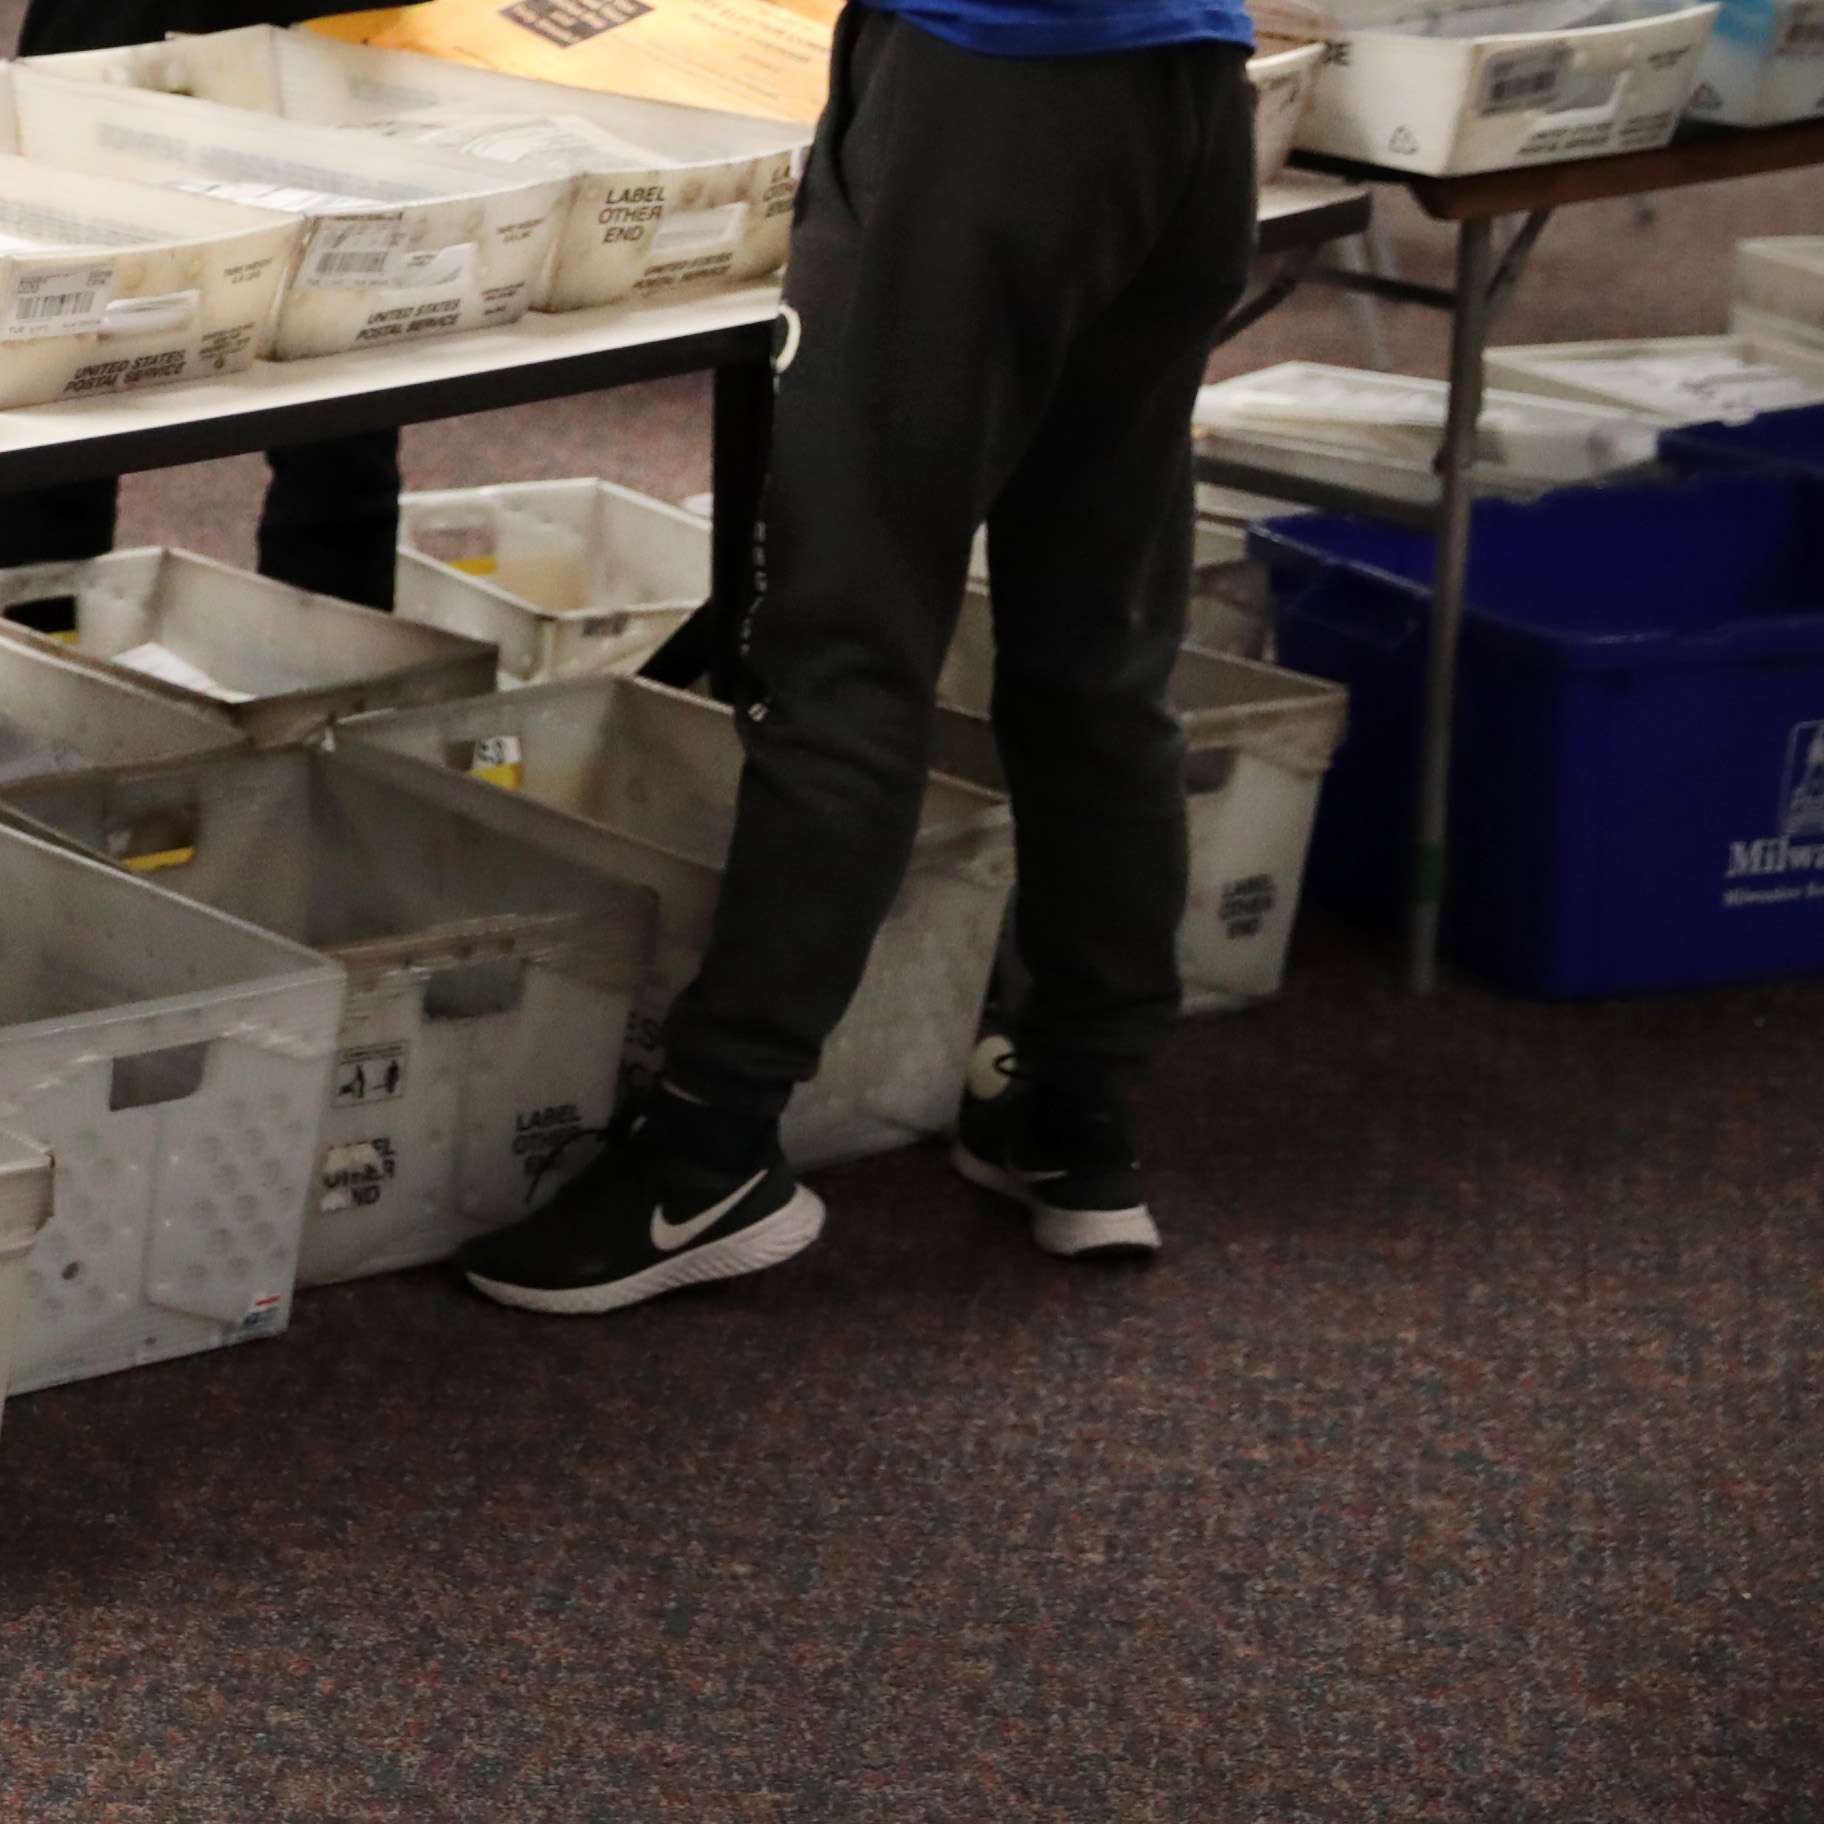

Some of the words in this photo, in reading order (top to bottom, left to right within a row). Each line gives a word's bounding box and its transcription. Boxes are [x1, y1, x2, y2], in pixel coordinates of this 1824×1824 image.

[605, 186, 665, 204] LABEL
[598, 205, 663, 224] OTHER
[603, 226, 644, 243] END
[515, 1104, 582, 1133] LABEL
